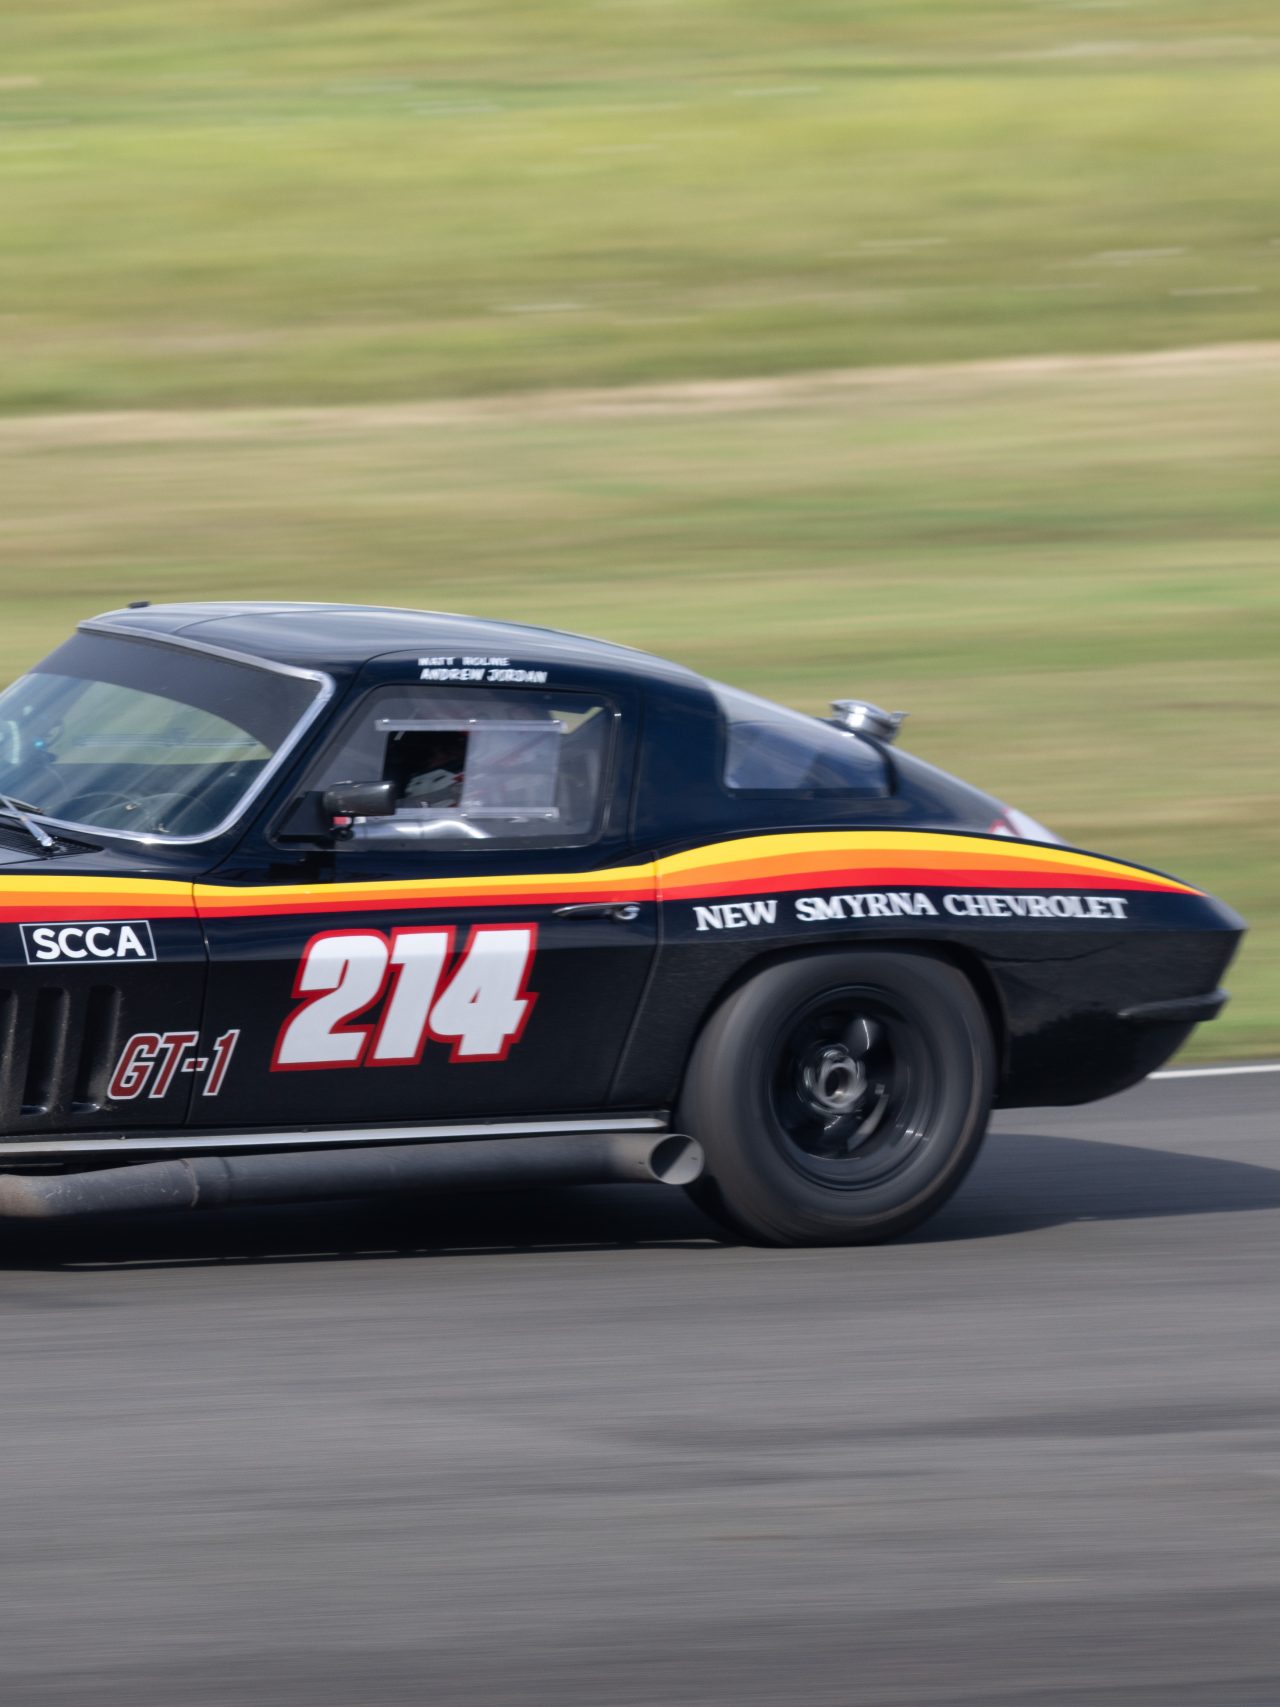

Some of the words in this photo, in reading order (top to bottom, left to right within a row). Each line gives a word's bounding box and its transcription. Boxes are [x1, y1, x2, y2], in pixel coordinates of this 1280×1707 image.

[420, 667, 486, 681] ANDREW
[487, 669, 548, 684] JORDAN
[693, 899, 778, 931] NEW
[794, 892, 940, 922] SMYRNA
[943, 893, 1129, 919] CHEVROLET
[32, 924, 147, 960] SCCA
[269, 922, 539, 1072] 214
[107, 1028, 241, 1100] GT-1
